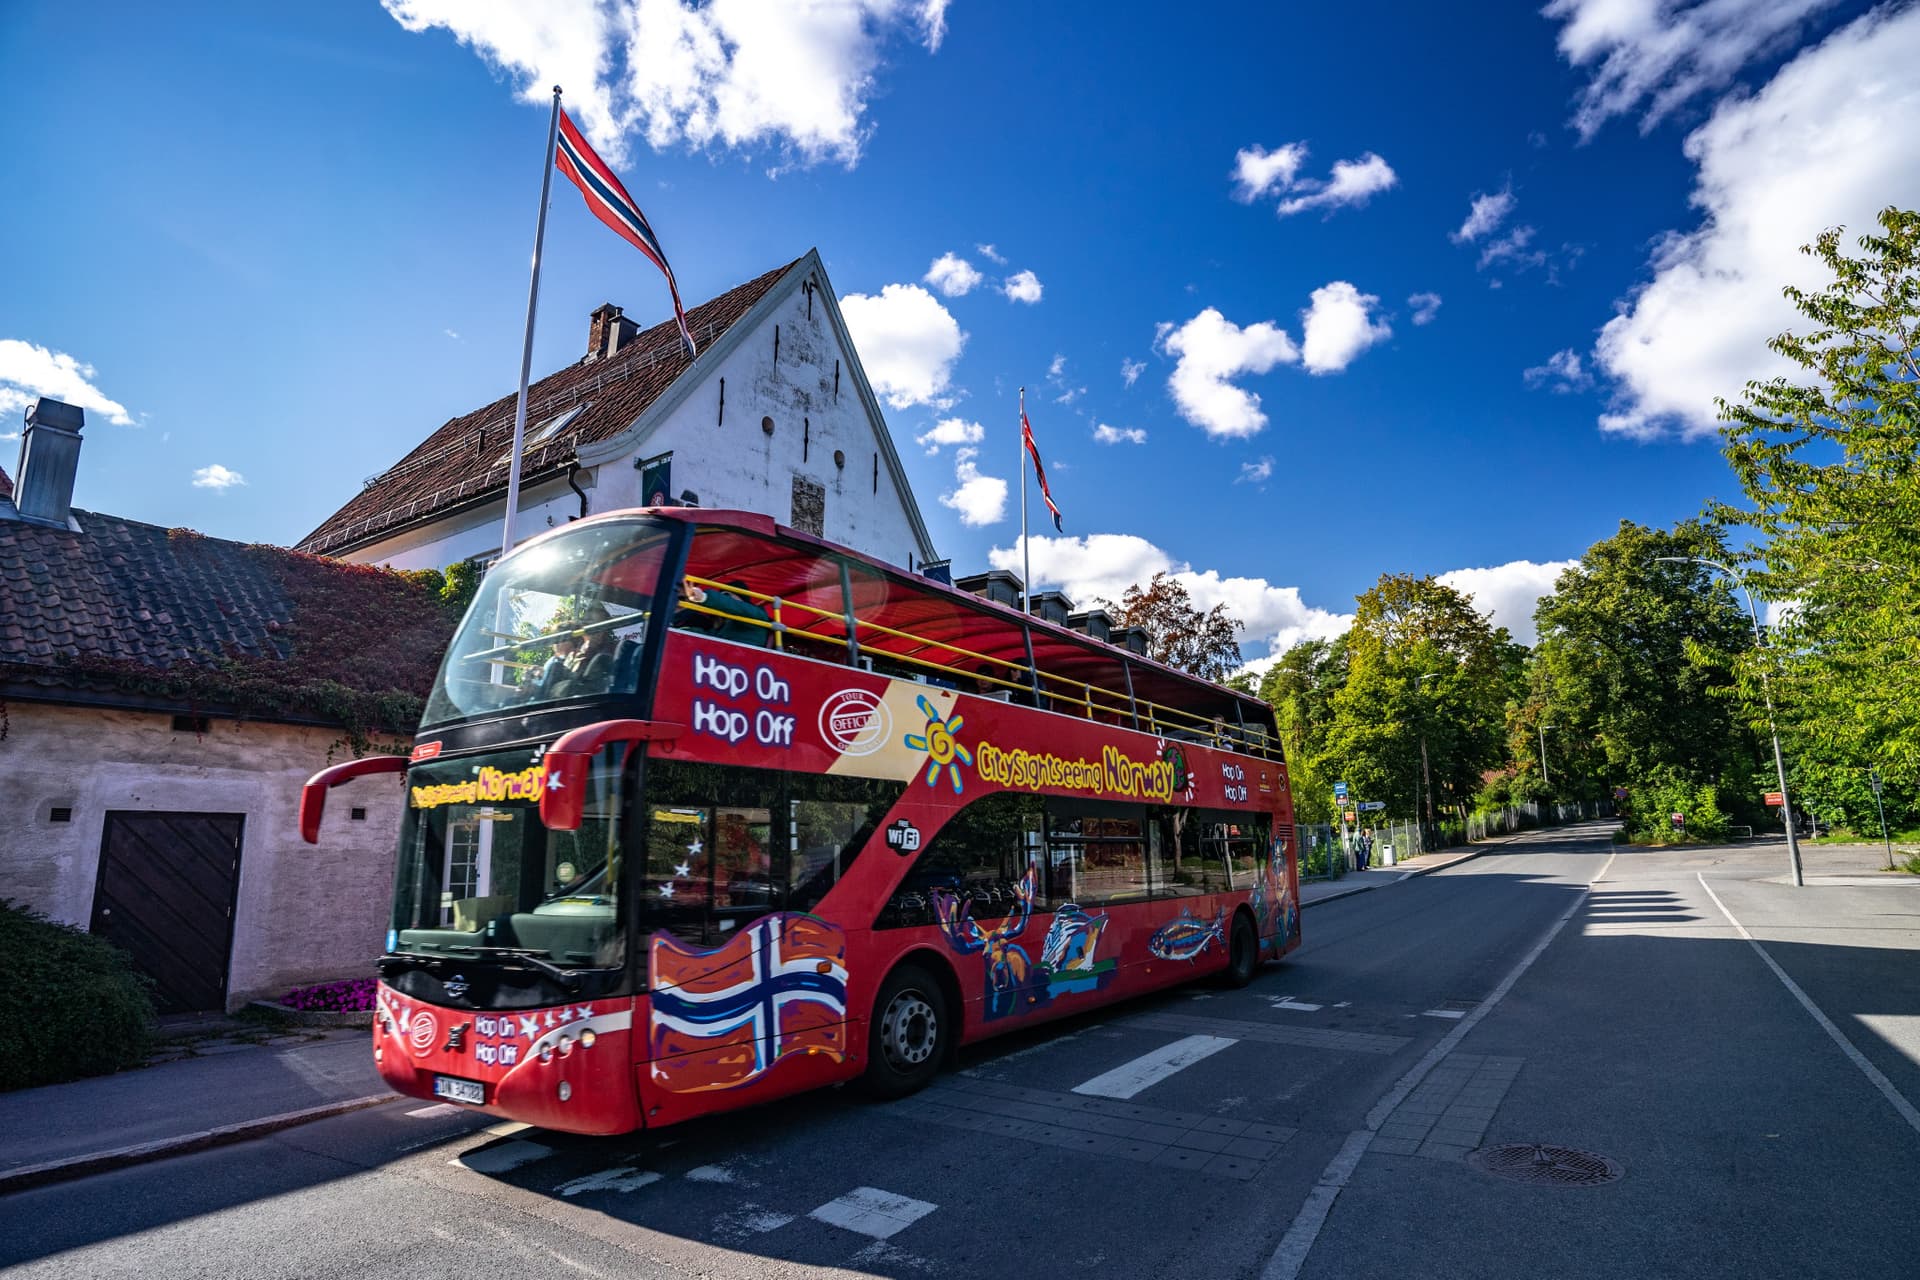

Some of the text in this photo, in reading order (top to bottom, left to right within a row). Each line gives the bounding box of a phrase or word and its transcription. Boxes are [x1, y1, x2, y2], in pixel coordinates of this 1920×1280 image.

[694, 654, 791, 703] Hop On
[694, 700, 796, 745] Hop Off
[1103, 745, 1175, 804] Norway
[1222, 763, 1245, 781] Hop On
[1224, 784, 1238, 802] Hop
[1237, 785, 1247, 801] Off
[475, 1016, 515, 1038] Hop On
[475, 1042, 518, 1066] Hop Off
